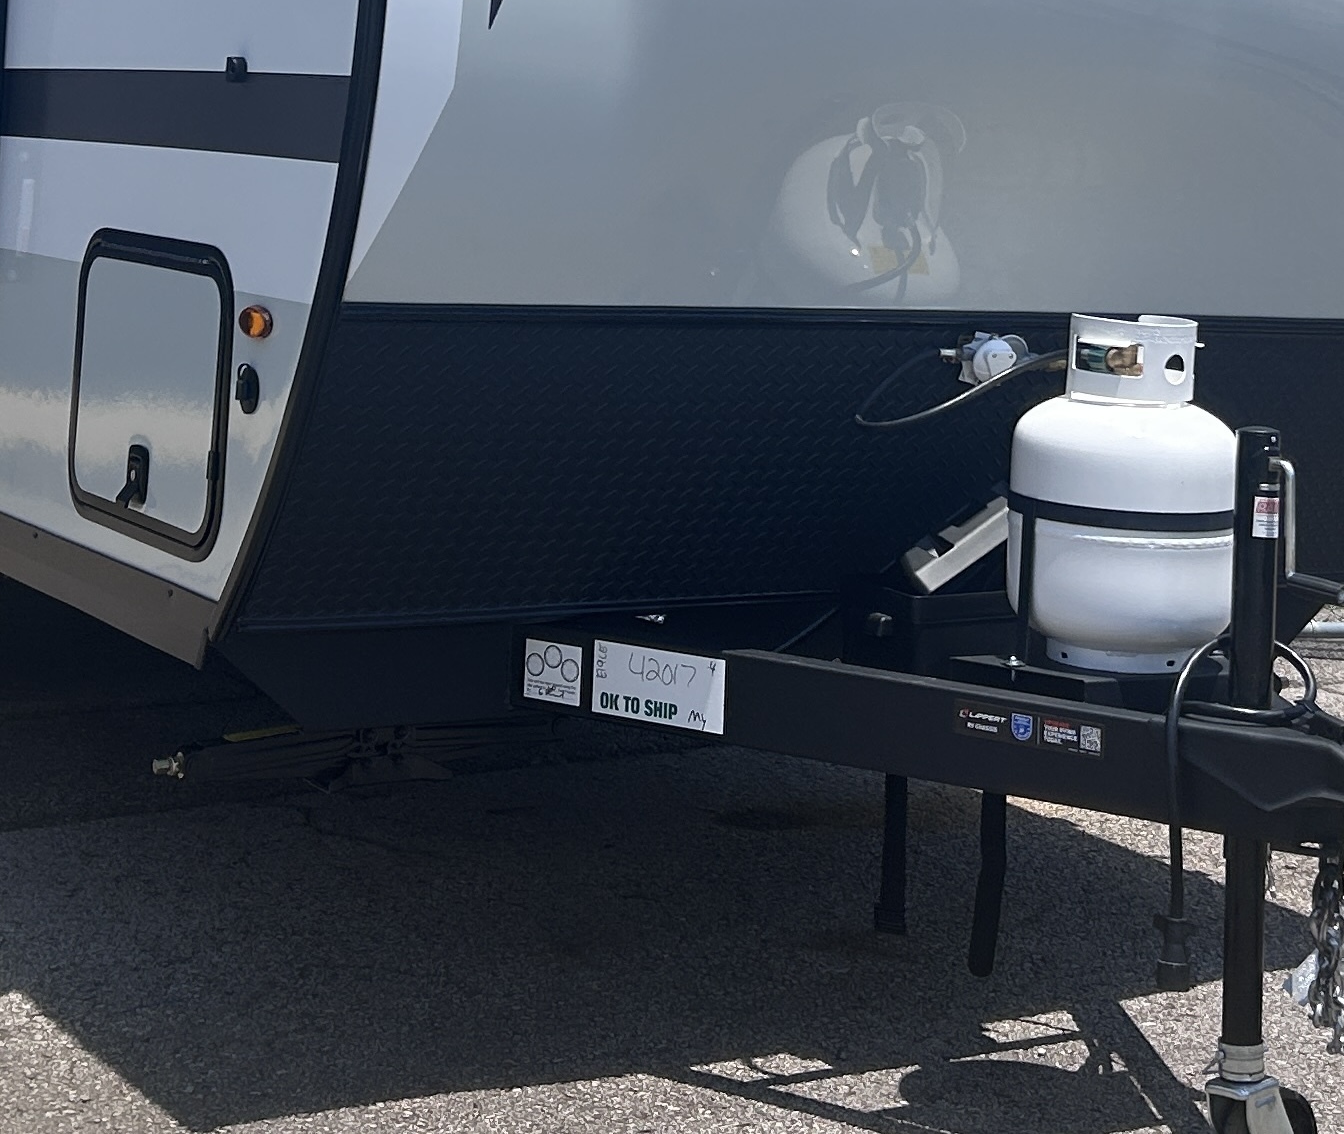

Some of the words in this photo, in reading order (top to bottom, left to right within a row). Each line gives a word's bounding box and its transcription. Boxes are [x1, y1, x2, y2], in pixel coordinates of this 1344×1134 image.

[599, 691, 620, 711] OK
[622, 695, 641, 715] TO
[644, 698, 679, 721] SHIP
[968, 711, 1008, 724] LIPPERT
